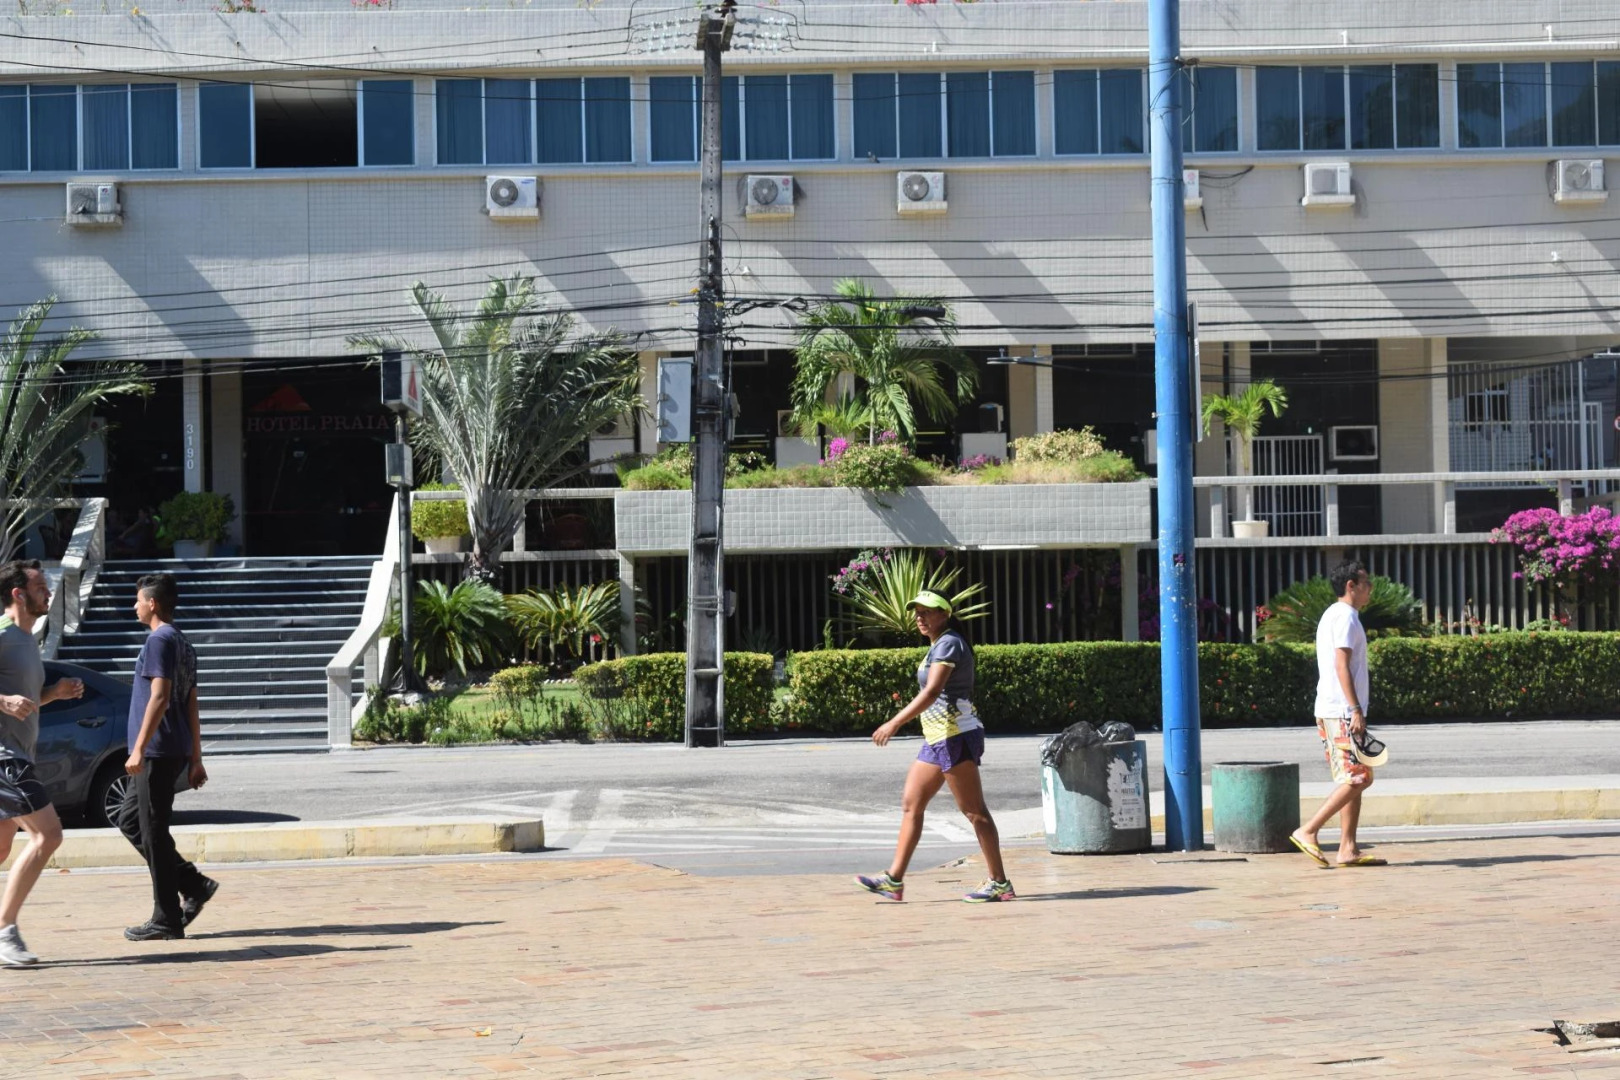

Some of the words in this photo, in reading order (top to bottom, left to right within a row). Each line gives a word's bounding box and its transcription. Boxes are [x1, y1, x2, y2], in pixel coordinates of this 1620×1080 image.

[247, 416, 315, 432] HOTEL
[320, 414, 390, 430] PRAIA
[186, 423, 195, 470] 3190
